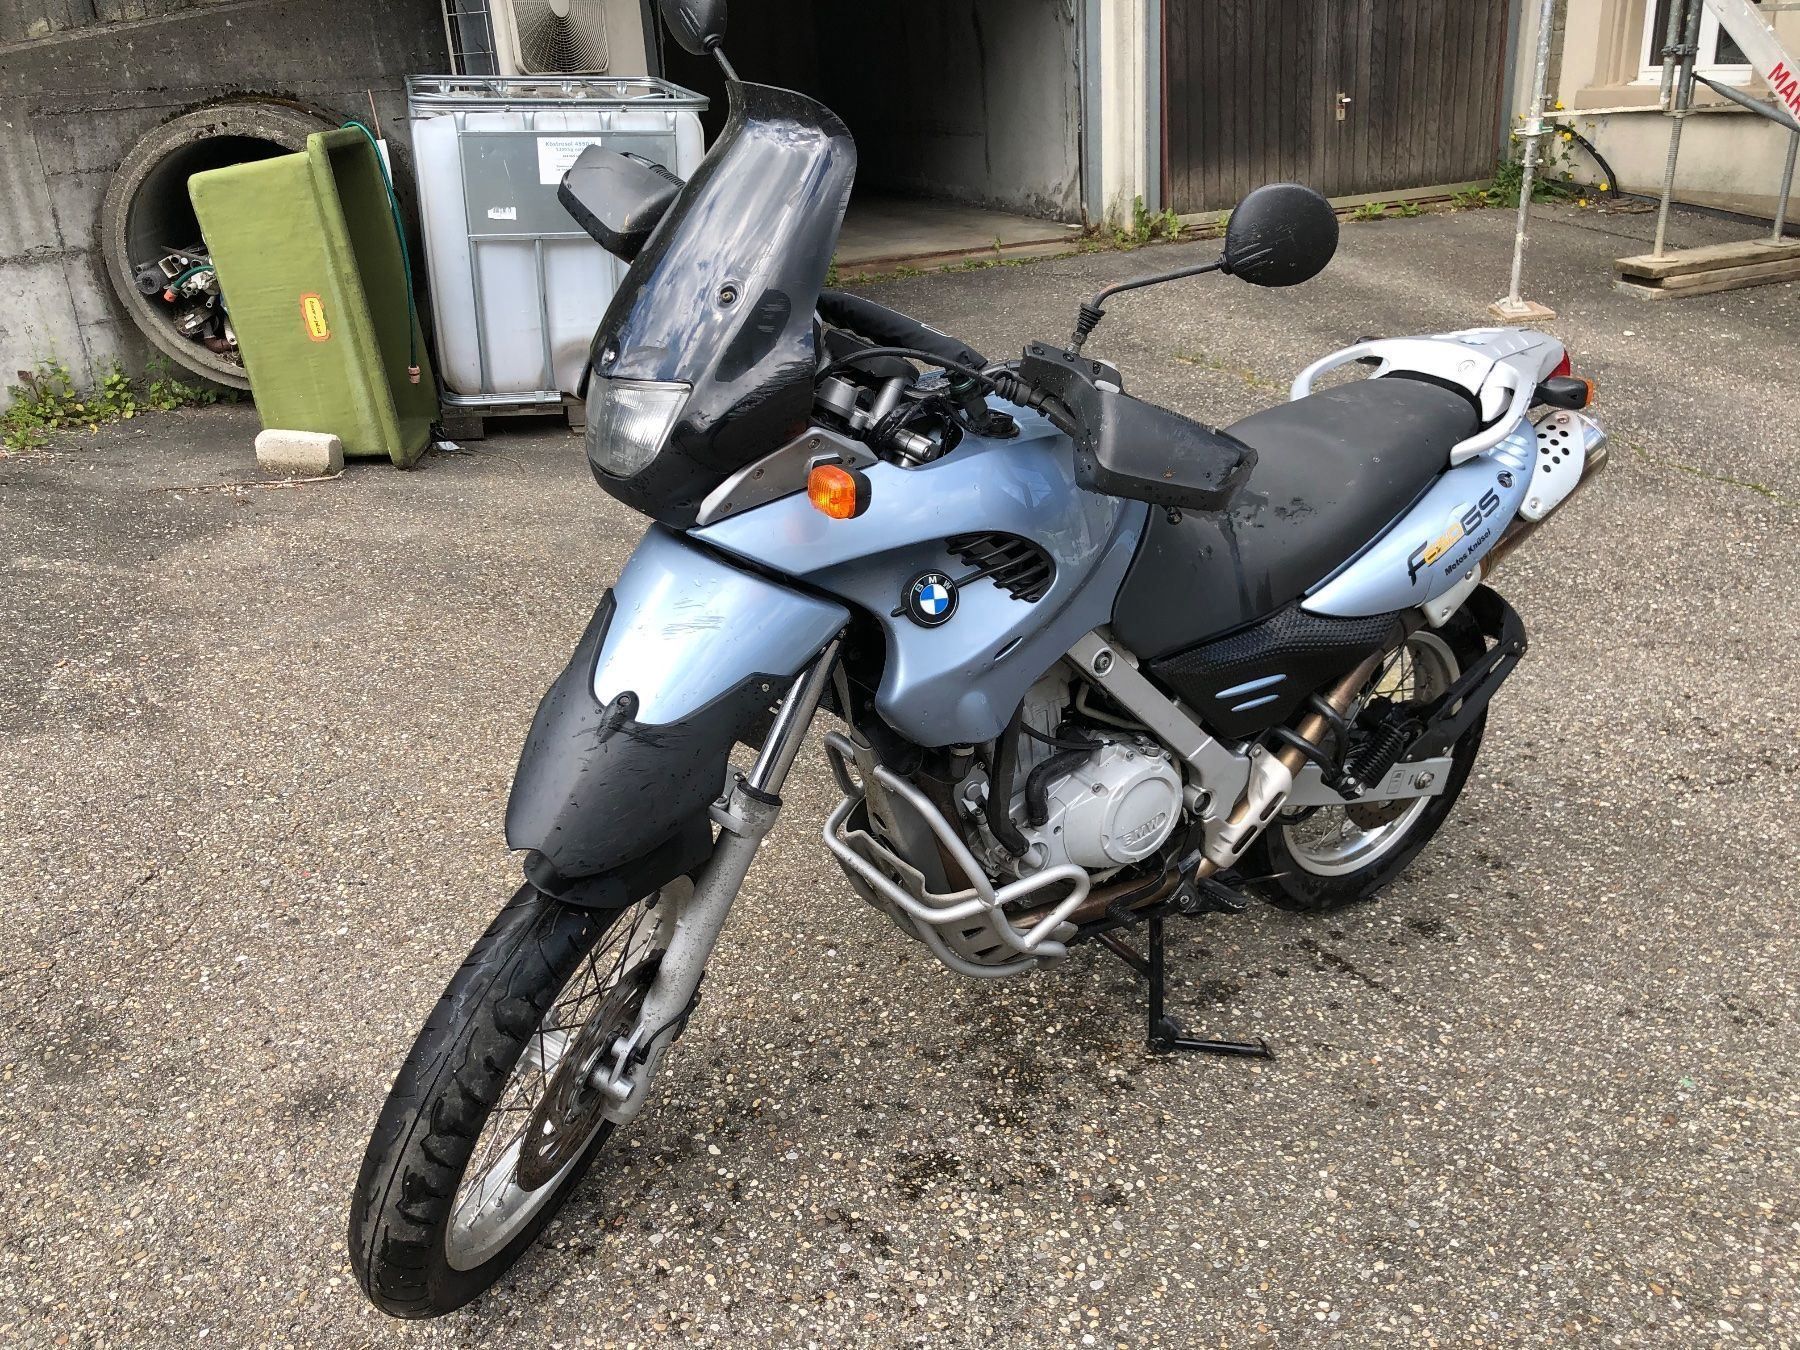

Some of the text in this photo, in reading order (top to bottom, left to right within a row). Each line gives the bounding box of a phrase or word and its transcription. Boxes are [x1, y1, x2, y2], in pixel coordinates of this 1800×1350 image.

[1444, 554, 1468, 576] Motos
[914, 575, 952, 593] BMW
[1121, 815, 1163, 849] BMW
